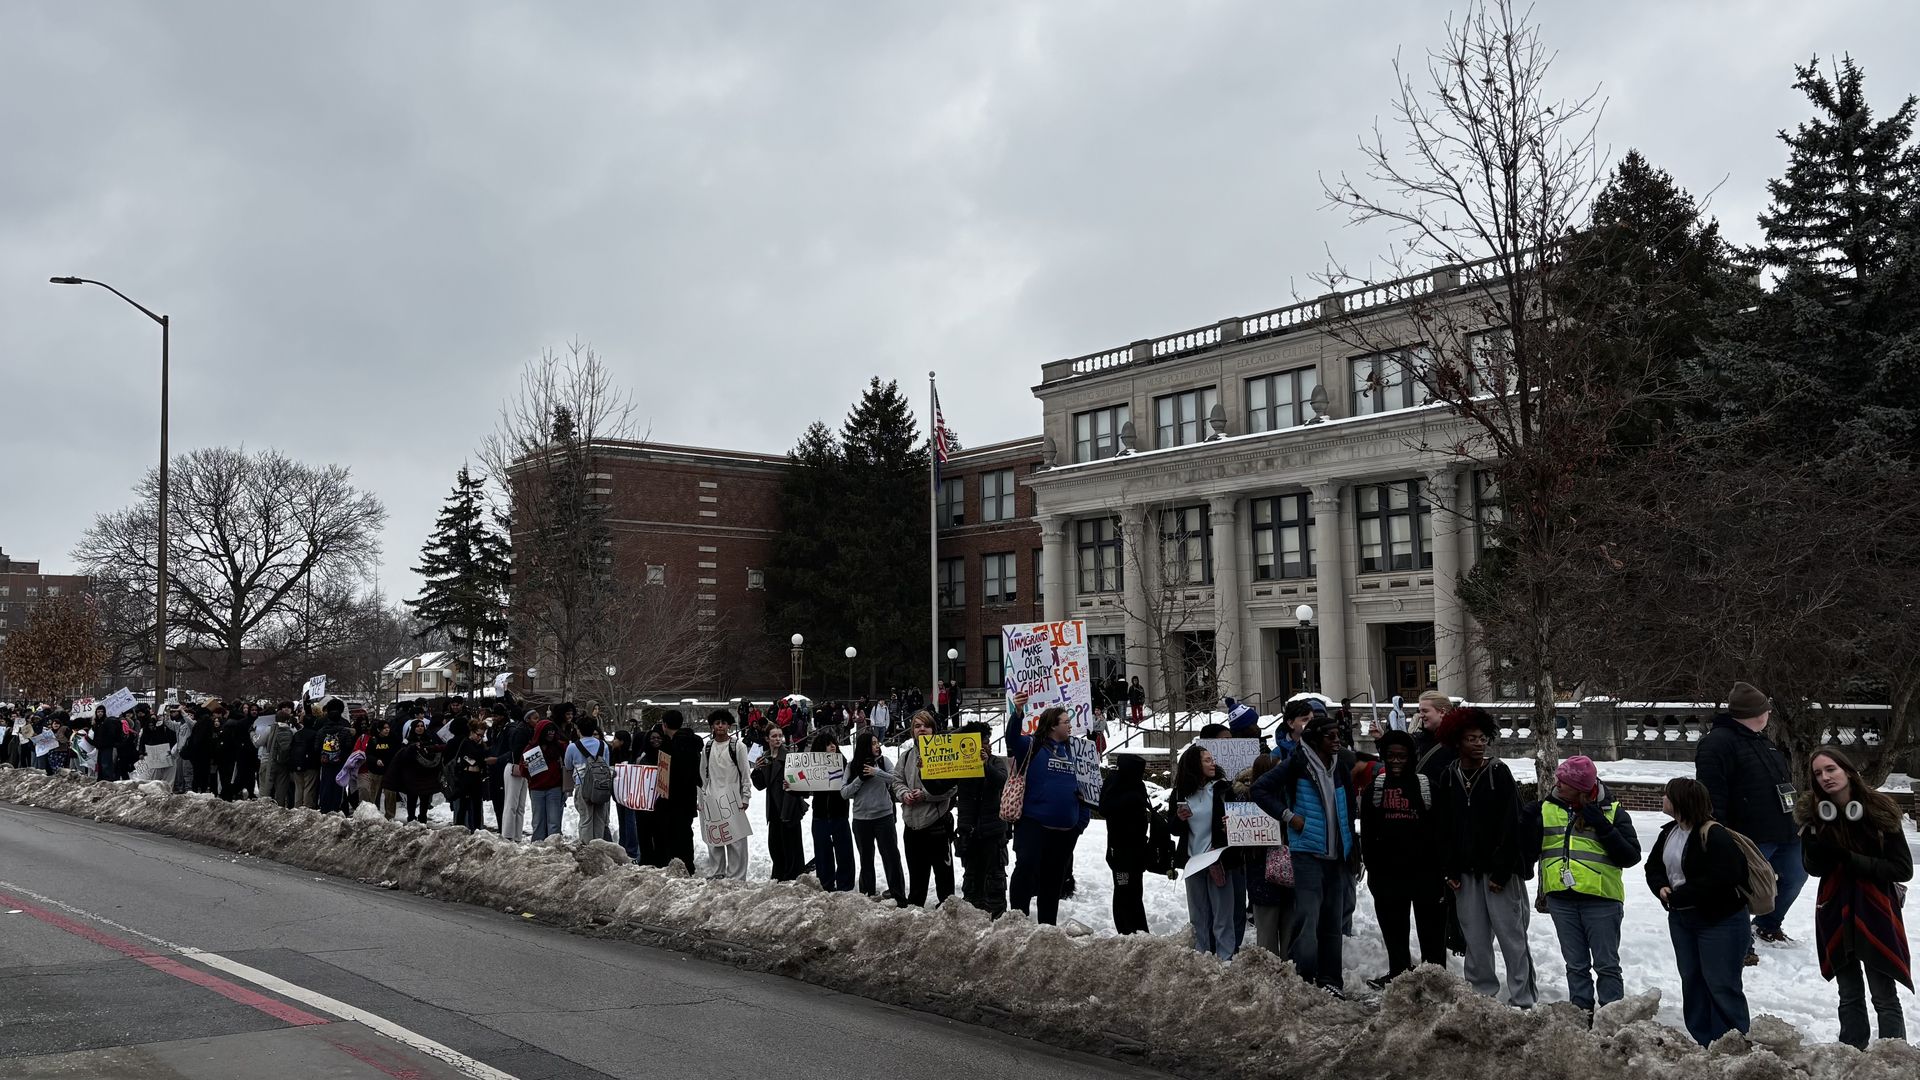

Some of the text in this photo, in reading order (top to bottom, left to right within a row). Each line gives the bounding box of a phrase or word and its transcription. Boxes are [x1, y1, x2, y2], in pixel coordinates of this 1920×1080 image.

[1236, 343, 1319, 369] EDUCATION CULTURE
[1194, 364, 1219, 379] DRAMA
[1011, 631, 1049, 651] IMMIGRANTS
[1022, 644, 1043, 658] MAKE
[1025, 656, 1042, 668] OUR
[1017, 665, 1052, 682] COUNTRY
[1021, 676, 1051, 697] GREAT
[923, 735, 952, 746] VOTE
[924, 746, 938, 757] IN
[1220, 740, 1246, 756] ONE
[1247, 740, 1260, 756] IS
[786, 753, 842, 768] ABOLISH
[1048, 761, 1076, 771] COLTS
[806, 767, 828, 780] ICE
[1236, 816, 1270, 829] MELTS
[707, 822, 733, 844] ICE
[1231, 829, 1279, 843] IN HELL
